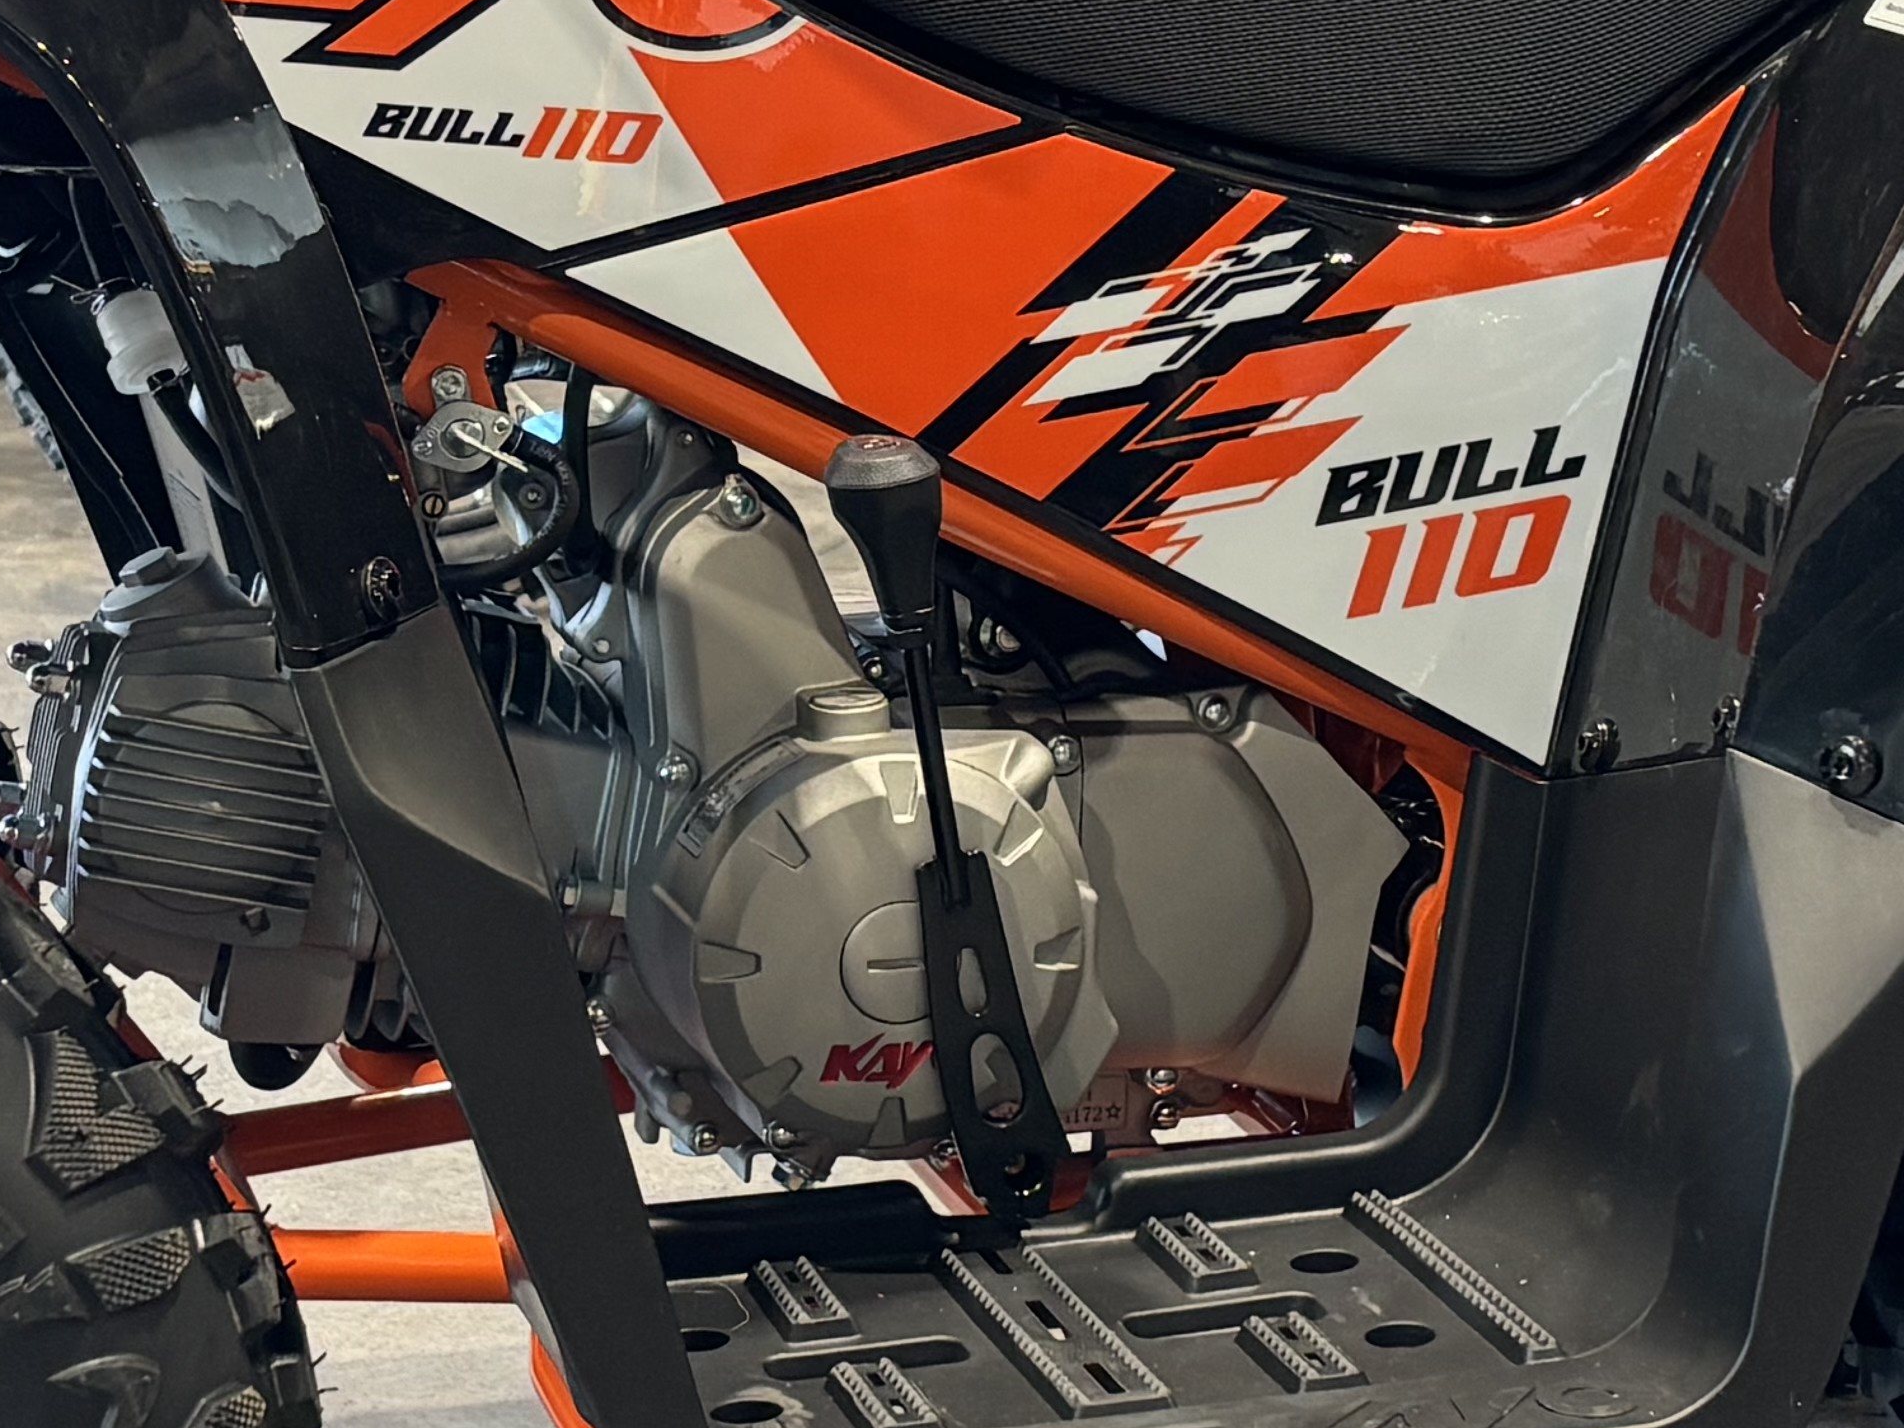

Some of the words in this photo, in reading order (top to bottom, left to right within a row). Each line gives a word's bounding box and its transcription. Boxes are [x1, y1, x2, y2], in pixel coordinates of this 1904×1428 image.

[1316, 425, 1586, 527] BULL
[1346, 493, 1572, 620] 110
[820, 1032, 936, 1090] KAY
